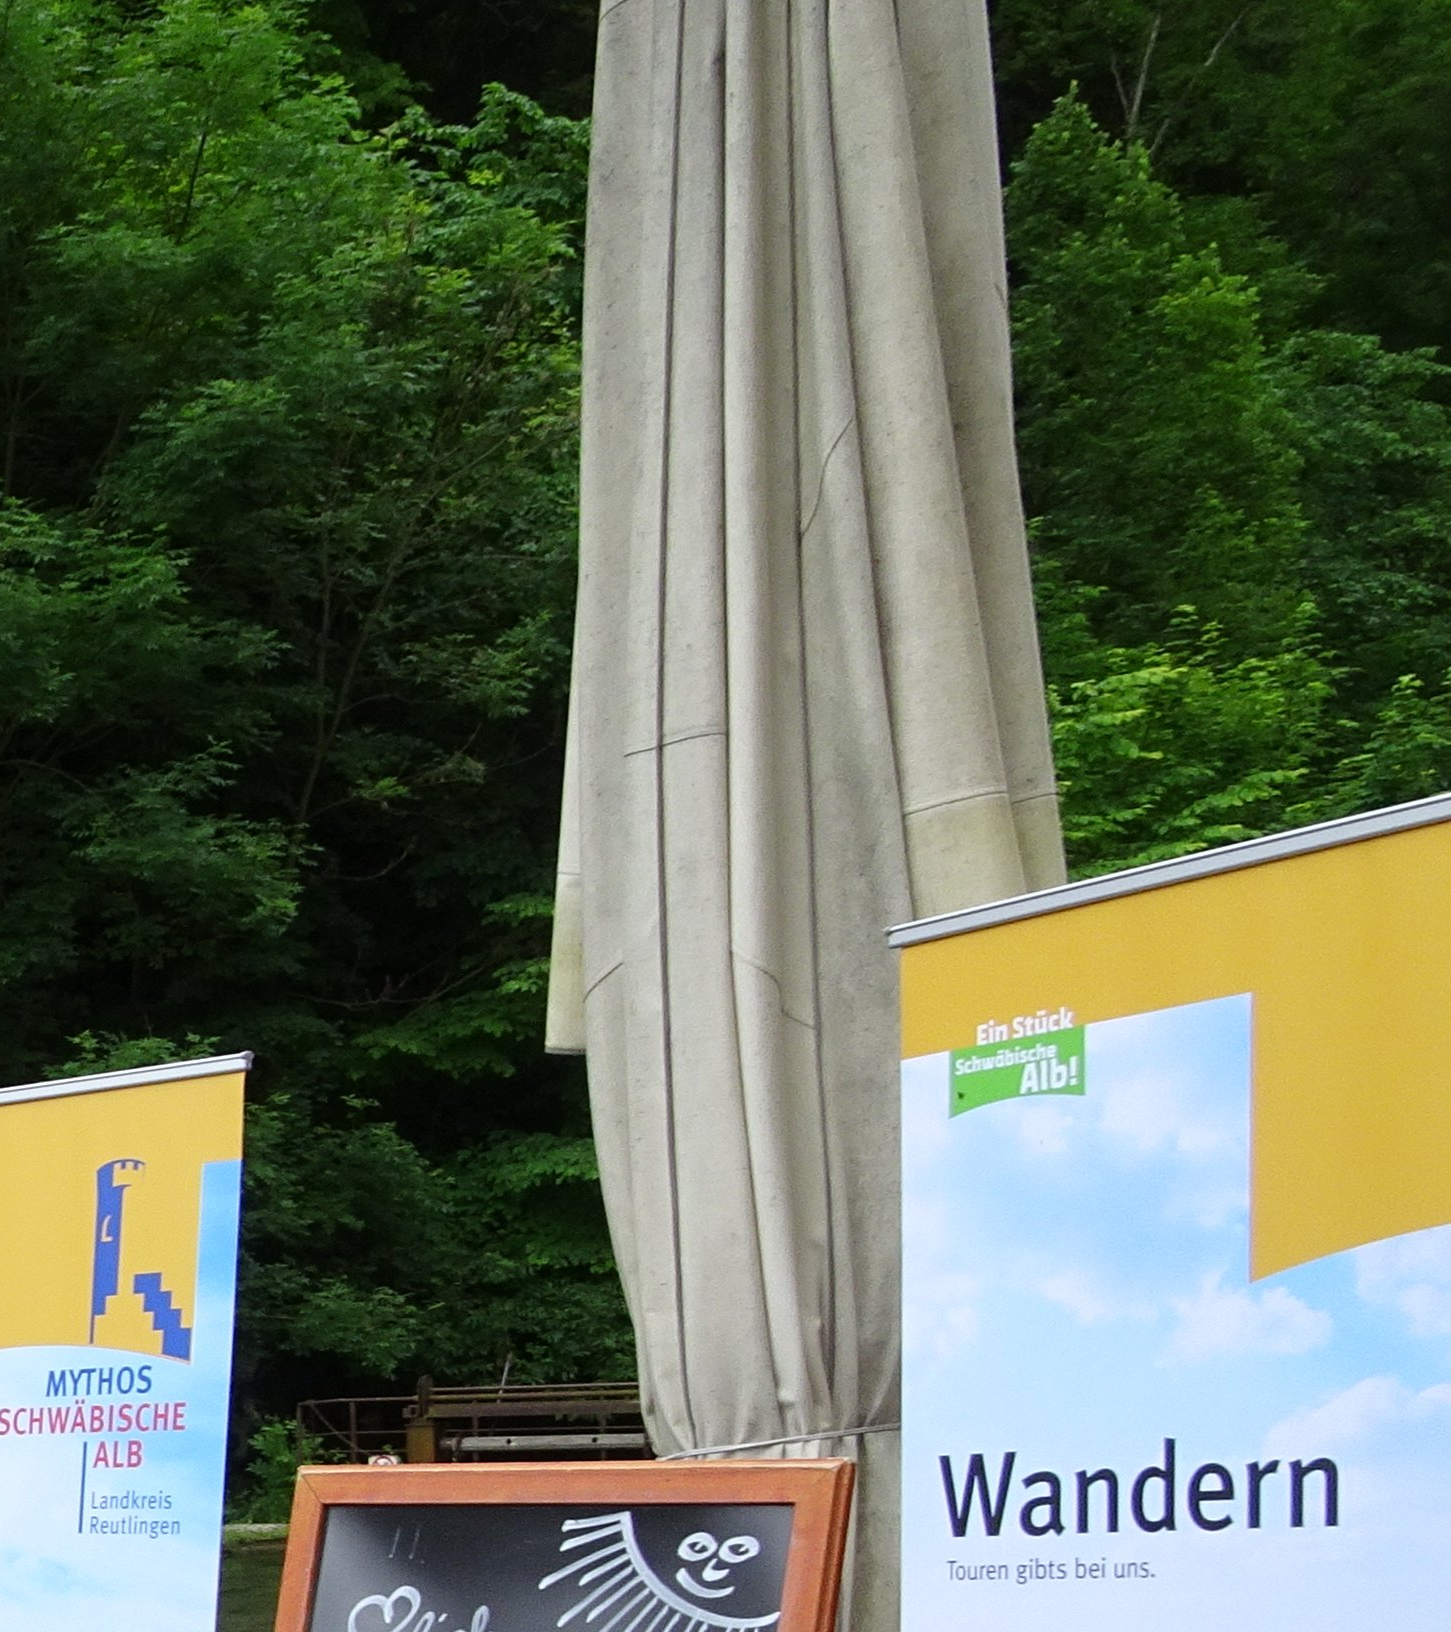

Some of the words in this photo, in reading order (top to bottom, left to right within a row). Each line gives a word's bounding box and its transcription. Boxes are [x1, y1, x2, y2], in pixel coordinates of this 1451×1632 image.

[976, 1021, 1009, 1046] Ein
[1012, 1007, 1074, 1039] Stück
[954, 1042, 1057, 1076] Schwäbische
[1019, 1056, 1079, 1094] Alb!
[45, 1365, 153, 1398] MYTHOS
[93, 1440, 143, 1469] ALB
[91, 1490, 173, 1511] Landkreis
[938, 1437, 1340, 1538] Wandern
[89, 1515, 181, 1537] Reutlingen
[946, 1560, 1009, 1582] Touren
[1015, 1559, 1068, 1585] gibts
[1075, 1559, 1107, 1580] bei
[1114, 1561, 1157, 1580] uns.
